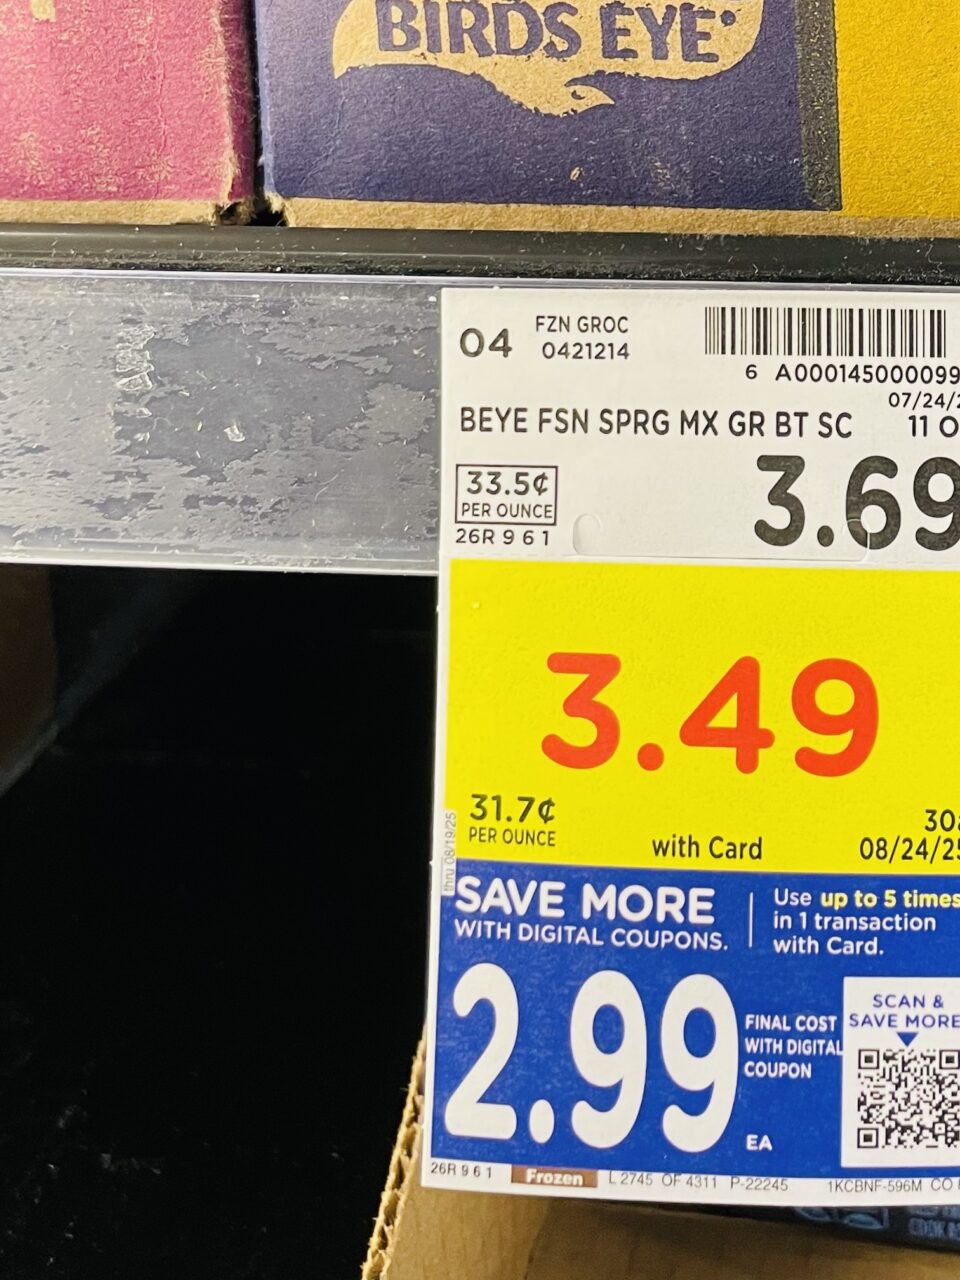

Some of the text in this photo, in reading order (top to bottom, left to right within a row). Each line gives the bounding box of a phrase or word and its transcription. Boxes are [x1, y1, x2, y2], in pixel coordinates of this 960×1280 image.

[600, 2, 720, 63] EYE
[535, 315, 629, 334] FZN GROC
[459, 327, 513, 359] 04
[542, 341, 630, 360] 0421214
[745, 364, 758, 380] 6
[460, 406, 853, 439] BEYE FSN SPRG MX GR BT SC
[908, 414, 928, 438] 11
[466, 470, 549, 496] 33.5¢
[461, 502, 553, 519] PER OUNCE
[455, 527, 549, 546] 26R 9 6 1
[541, 651, 879, 778] 3.49
[469, 793, 556, 824] 31.7¢
[468, 826, 557, 847] PER OUNCE
[652, 833, 763, 860] with Card
[455, 875, 716, 925] SAVE MORE
[774, 887, 812, 907] Use
[820, 890, 849, 911] up
[854, 890, 878, 908] to
[884, 889, 897, 908] 5
[773, 910, 937, 932] in 1 transaction
[454, 918, 729, 951] WITH DIGITAL COUPONS.
[773, 935, 885, 955] with Card.
[872, 993, 945, 1009] SCAN &
[745, 1013, 837, 1033] FINAL COST
[848, 1012, 899, 1029] SAVE
[444, 961, 739, 1153] 2.99
[745, 1037, 843, 1057] WITH DIGITAL
[744, 1061, 812, 1080] COUPON
[746, 1134, 773, 1151] EA
[430, 1160, 493, 1179] 26R 9 6 1
[525, 1168, 584, 1187] Frozen
[620, 1172, 653, 1187] 2745
[661, 1172, 682, 1187] OF
[686, 1173, 718, 1189] 4311
[730, 1176, 789, 1193] P-22245
[828, 1178, 922, 1194] 1KCBNF-596M
[931, 1178, 953, 1192] CO
